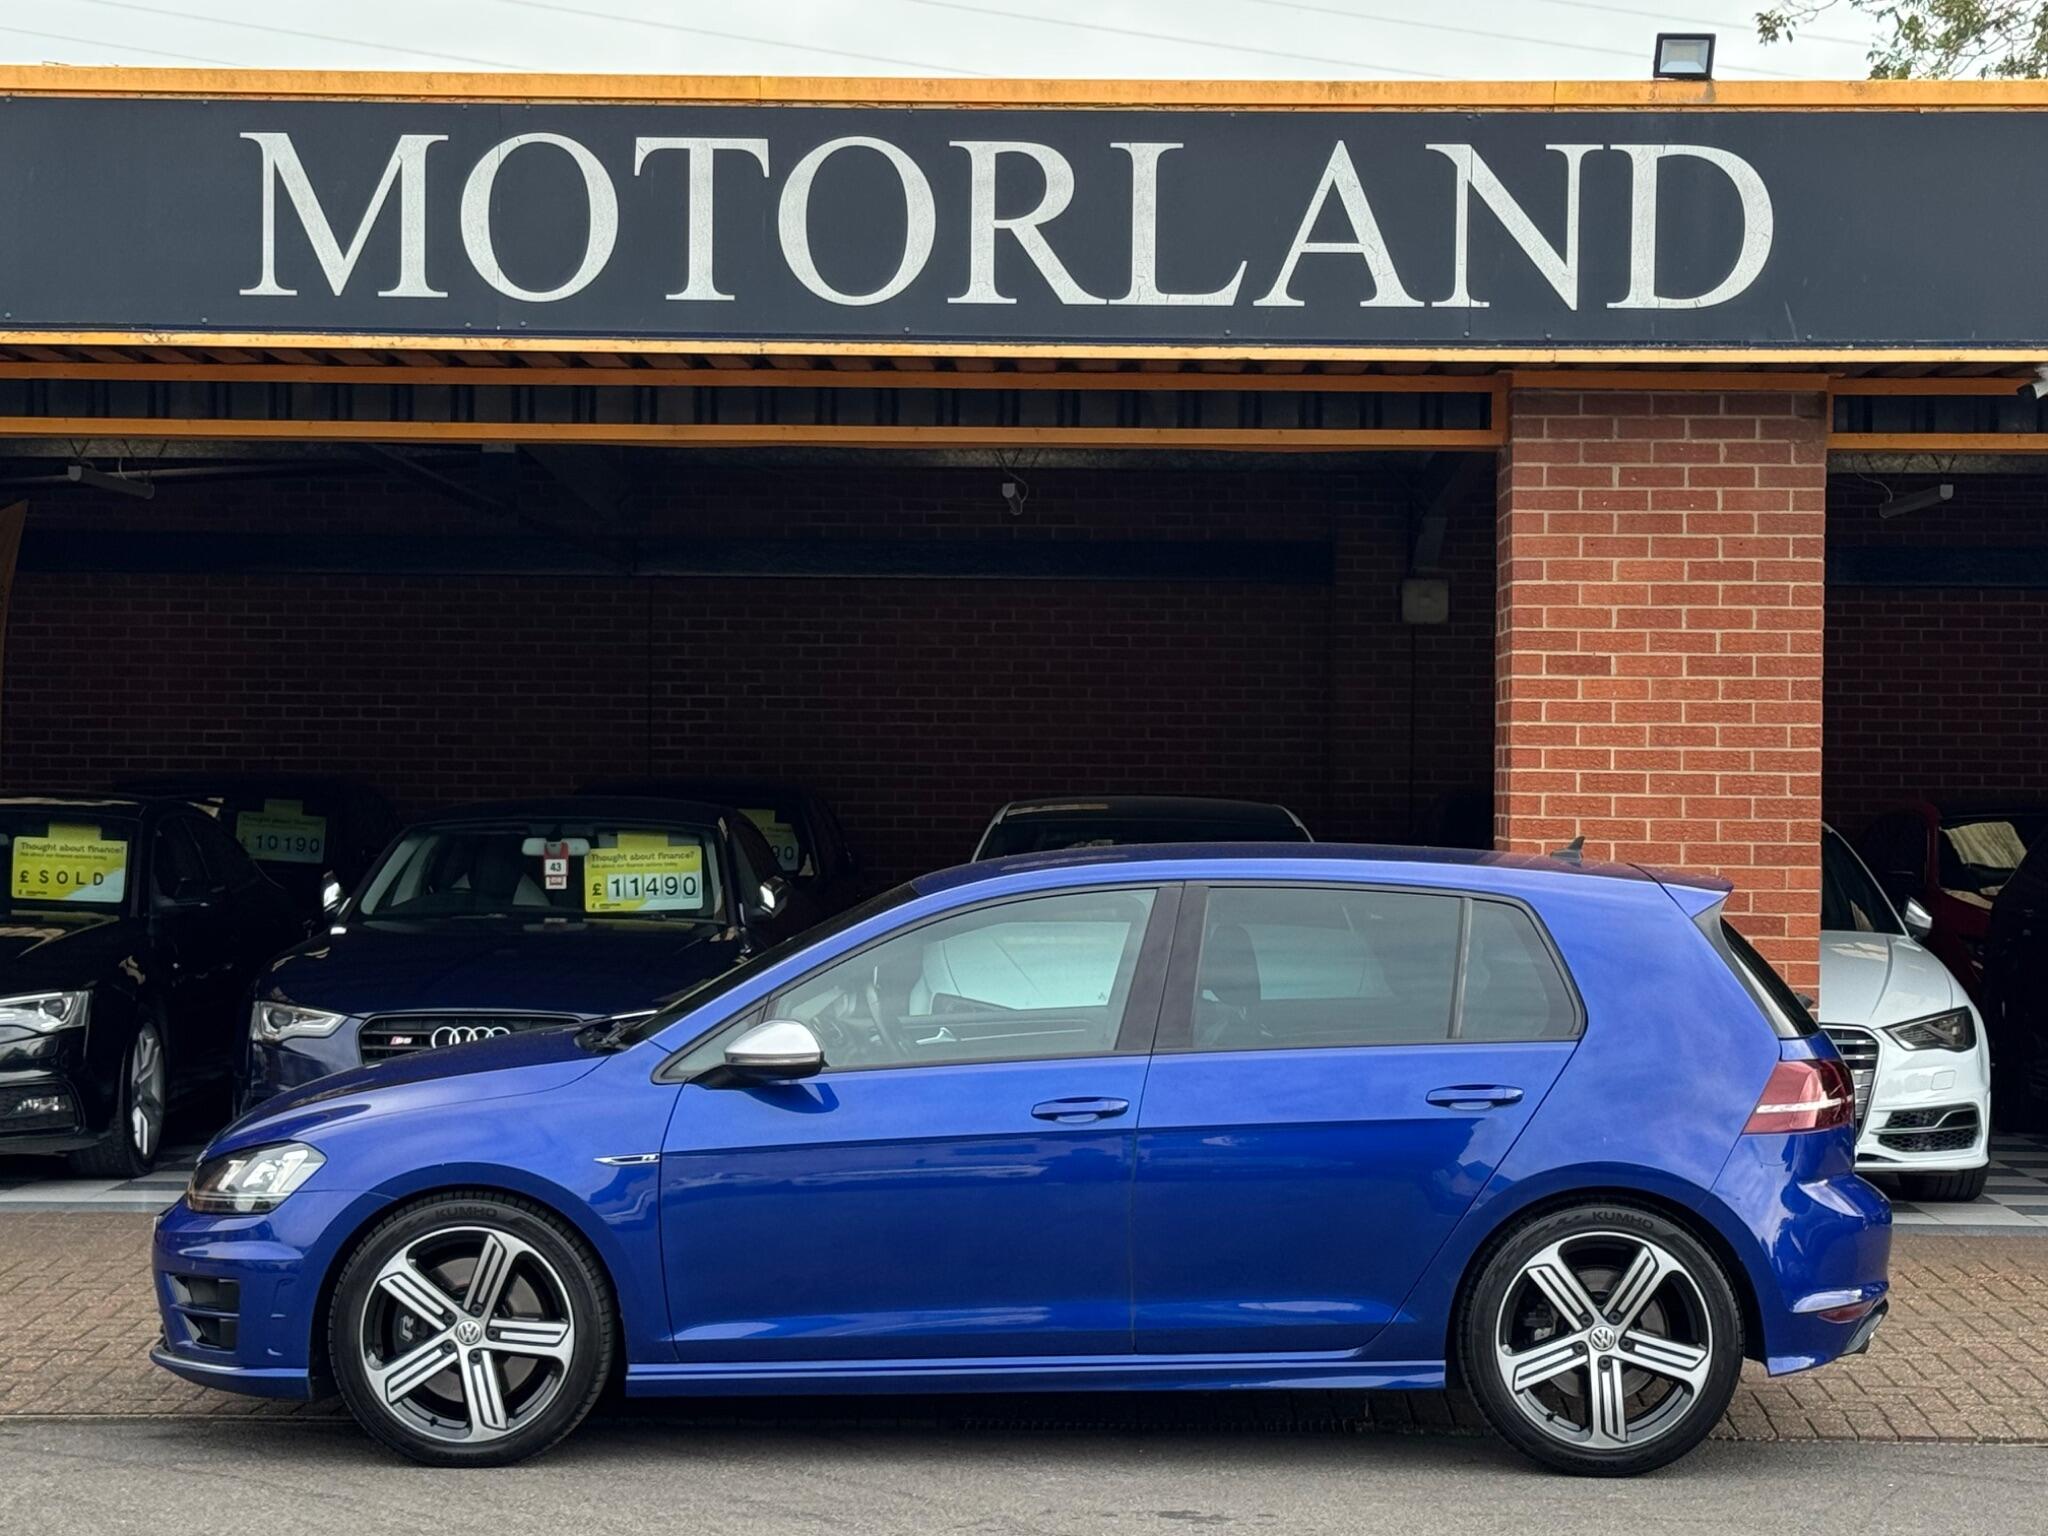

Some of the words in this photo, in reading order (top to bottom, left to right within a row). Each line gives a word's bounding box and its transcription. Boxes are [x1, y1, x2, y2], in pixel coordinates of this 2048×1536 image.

[239, 131, 1775, 311] MOTORLAND
[256, 835, 320, 854] 10190
[550, 862, 562, 872] 43
[39, 870, 104, 886] SOLD
[592, 883, 602, 896] £
[611, 876, 697, 897] 11490
[435, 1206, 498, 1219] KUMHO
[1592, 1210, 1655, 1229] KUMHO
